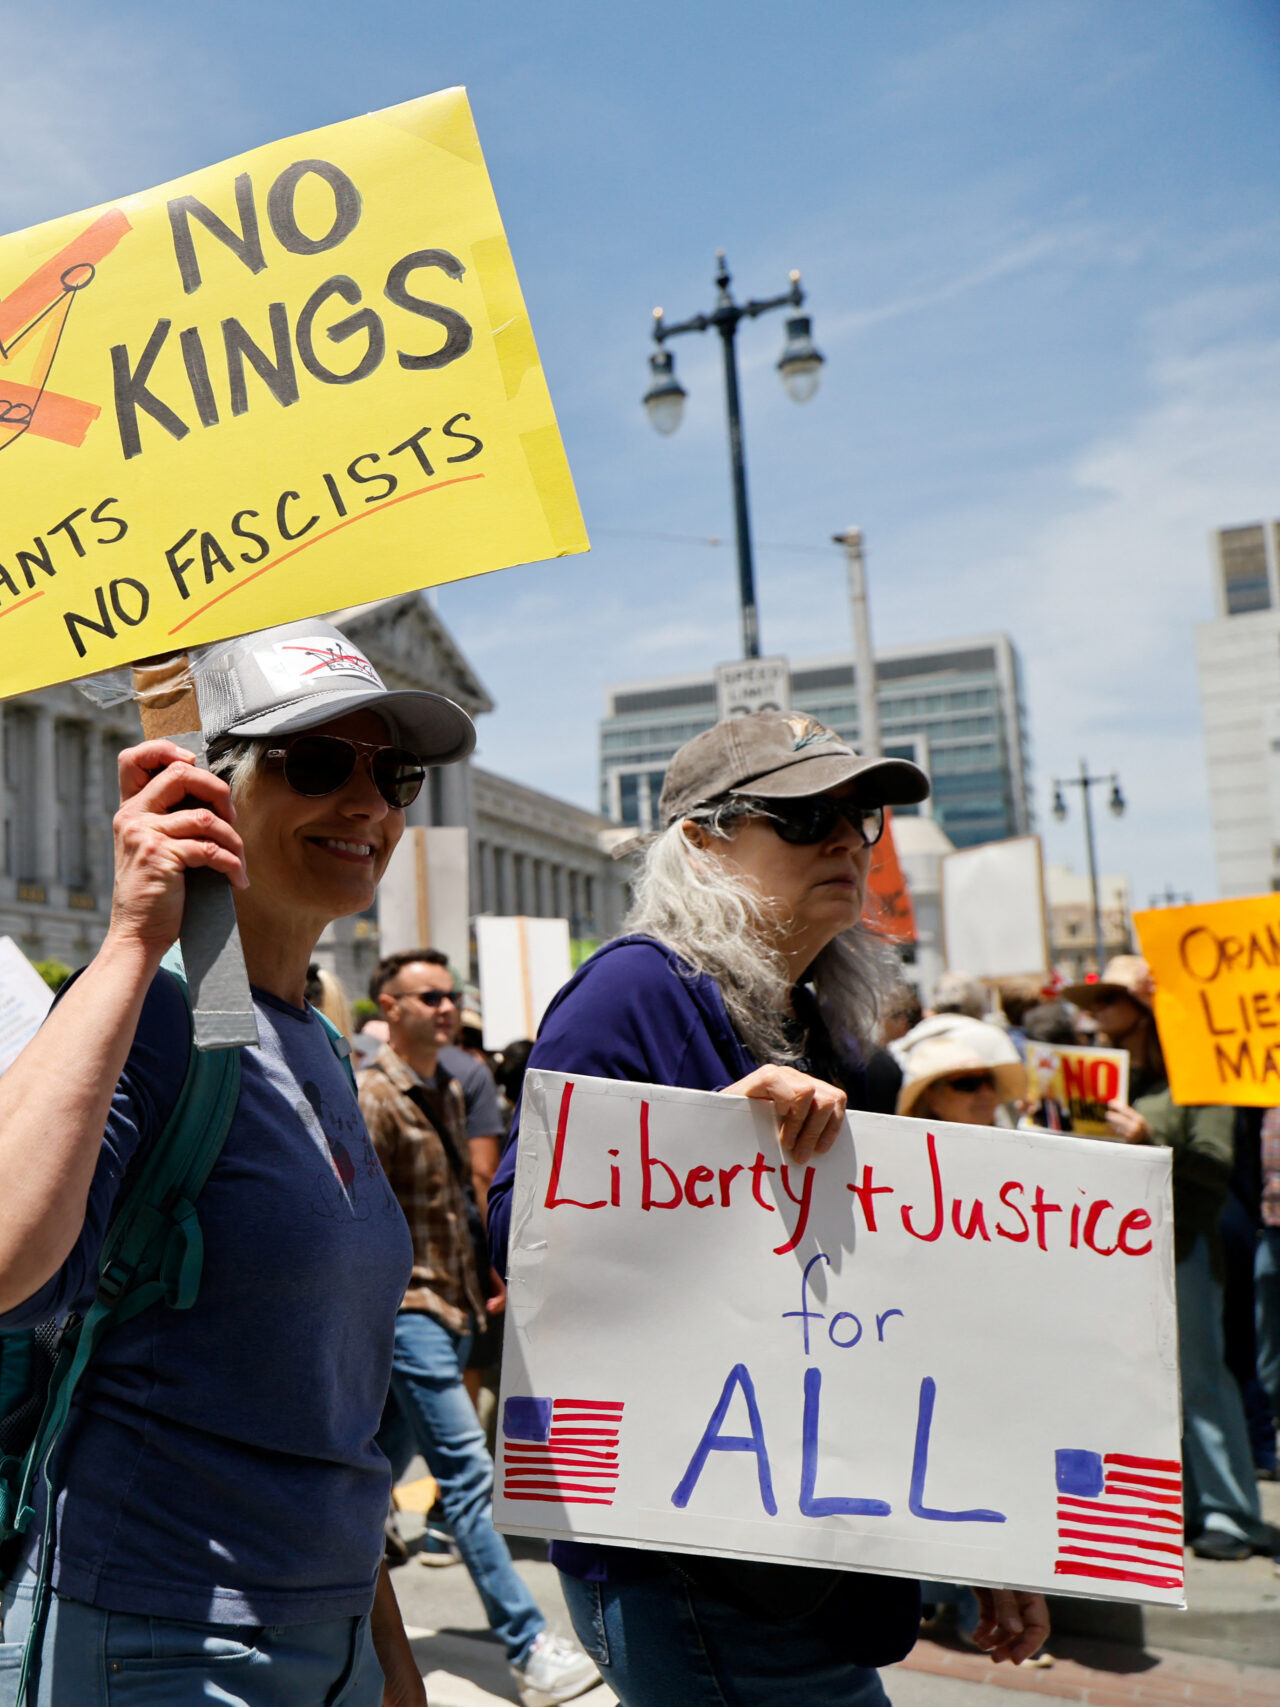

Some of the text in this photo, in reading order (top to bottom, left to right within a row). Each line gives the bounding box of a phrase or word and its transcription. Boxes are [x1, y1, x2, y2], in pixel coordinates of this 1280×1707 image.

[167, 158, 362, 295] NO
[110, 248, 475, 460] KINGS
[63, 412, 485, 658] NO FASCISTS
[1061, 1055, 1120, 1105] NO
[1200, 988, 1280, 1036] LIE
[543, 1081, 817, 1256] Liberty
[900, 1132, 1154, 1258] Justice
[782, 1253, 905, 1355] for
[670, 1362, 1008, 1524] ALL
